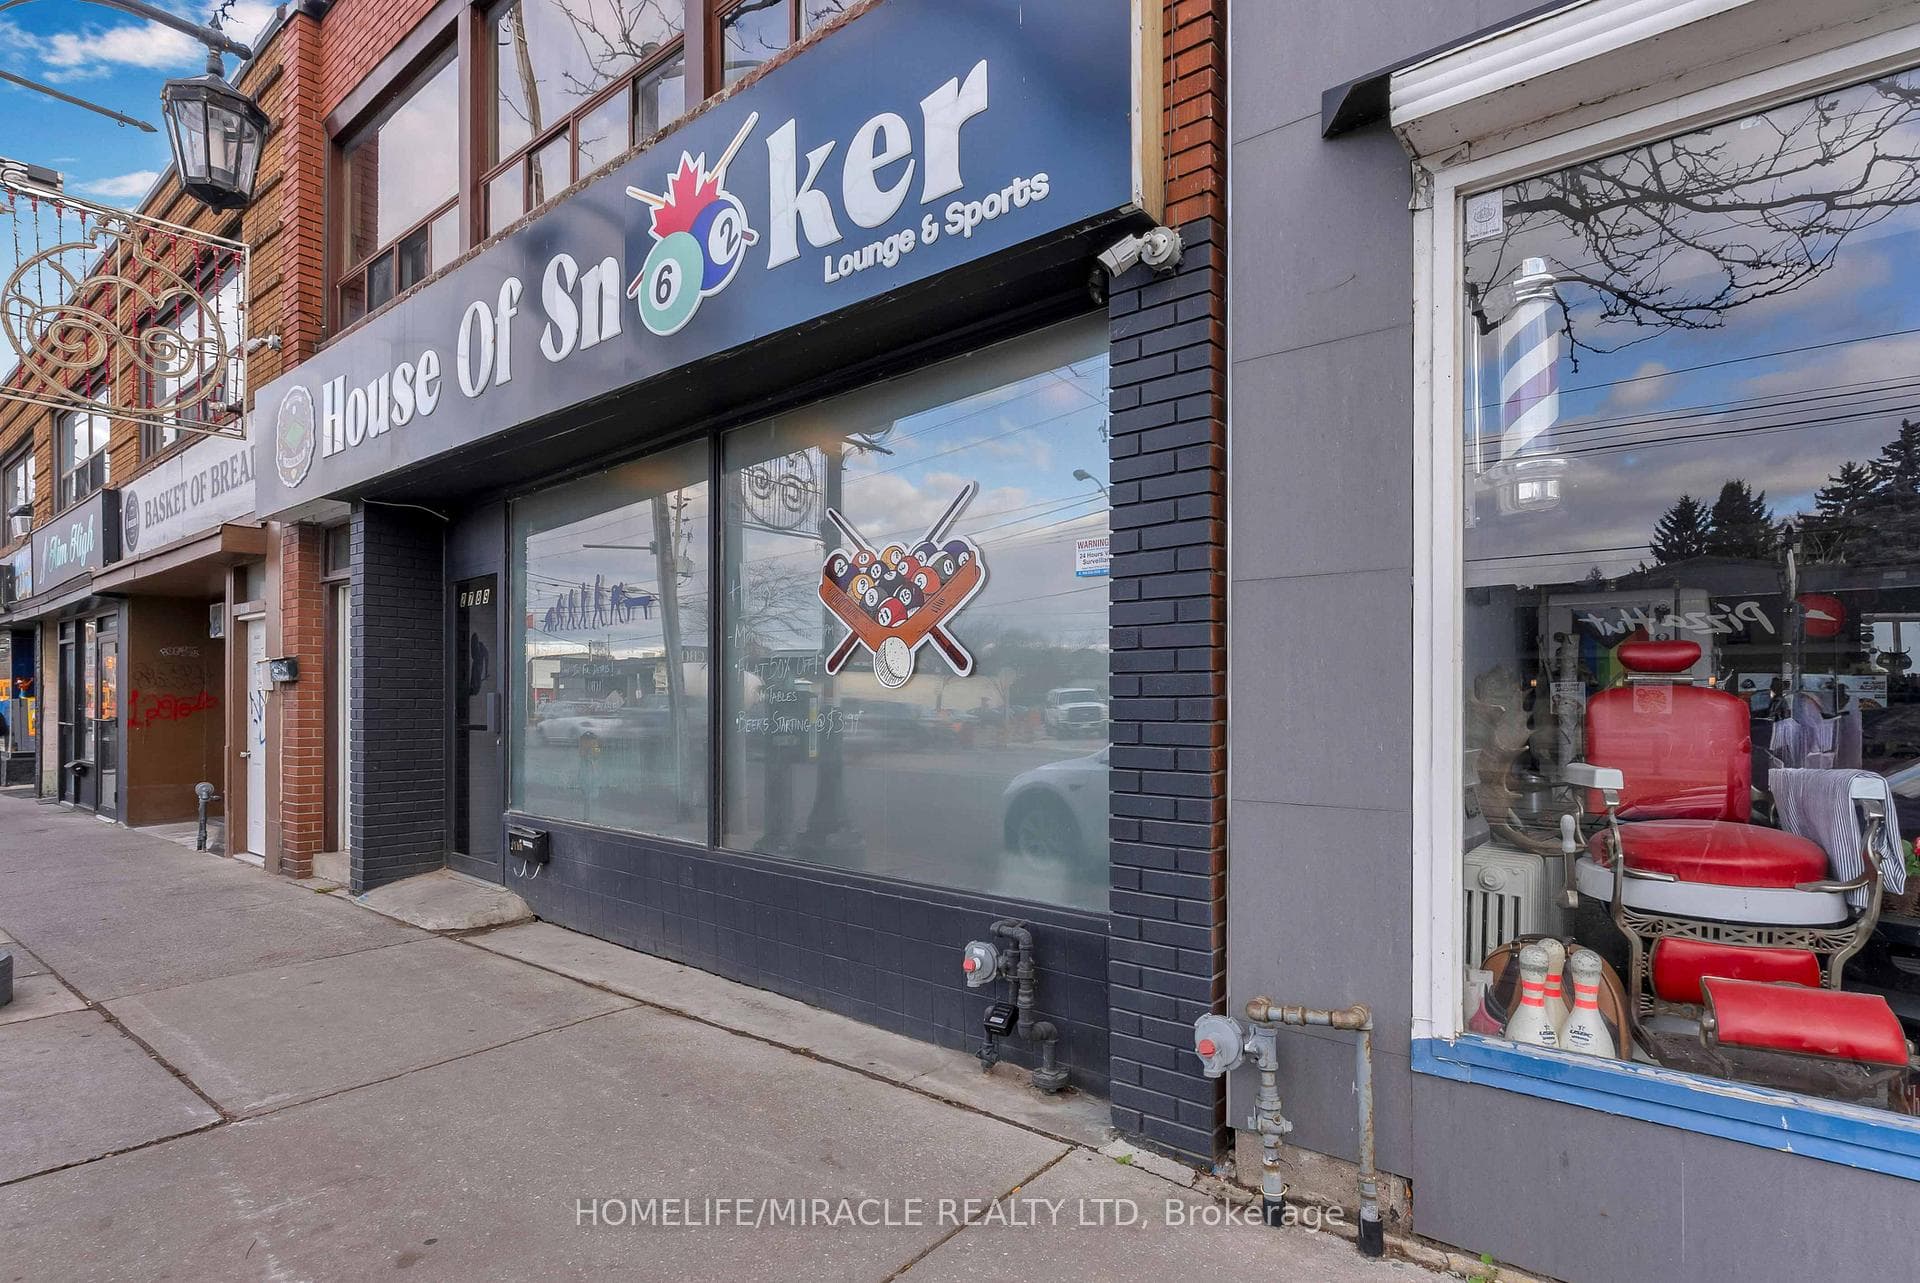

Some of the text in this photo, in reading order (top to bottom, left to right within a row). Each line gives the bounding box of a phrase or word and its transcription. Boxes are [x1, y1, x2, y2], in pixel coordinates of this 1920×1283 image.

[824, 172, 1050, 284] Lounge & Sports
[322, 350, 442, 459] House
[457, 276, 523, 398] Of
[145, 480, 188, 529] BASKET
[190, 470, 207, 507] OF
[69, 514, 95, 567] High
[880, 609, 890, 624] 11
